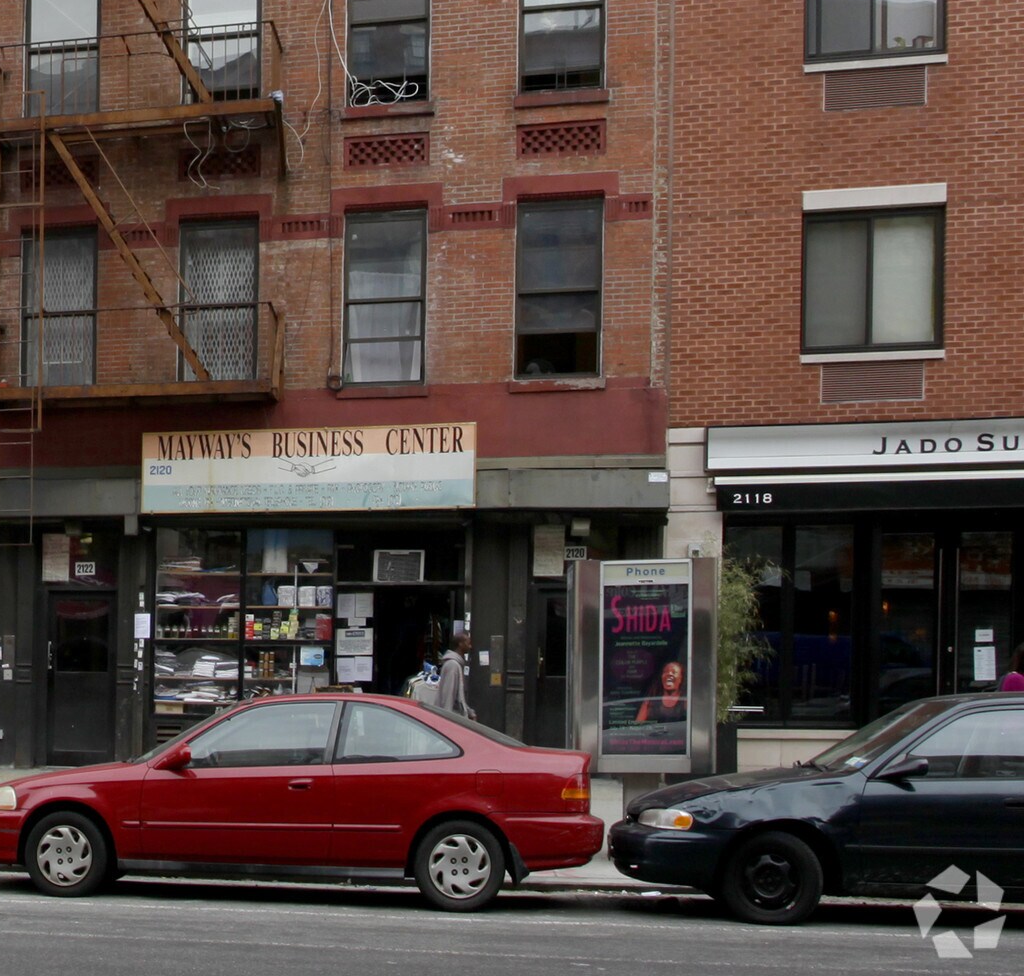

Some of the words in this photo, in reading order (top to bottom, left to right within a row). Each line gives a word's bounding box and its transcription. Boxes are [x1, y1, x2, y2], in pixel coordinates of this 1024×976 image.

[158, 432, 251, 460] MAYWAY'S
[272, 430, 364, 458] BUSINESS
[386, 426, 464, 455] CENTER
[872, 437, 963, 454] JADO
[149, 465, 172, 475] 2120
[733, 493, 773, 504] 2118
[565, 548, 585, 558] 2120
[76, 564, 94, 574] 2122
[626, 568, 666, 576] Phone
[611, 595, 672, 633] SHIDA
